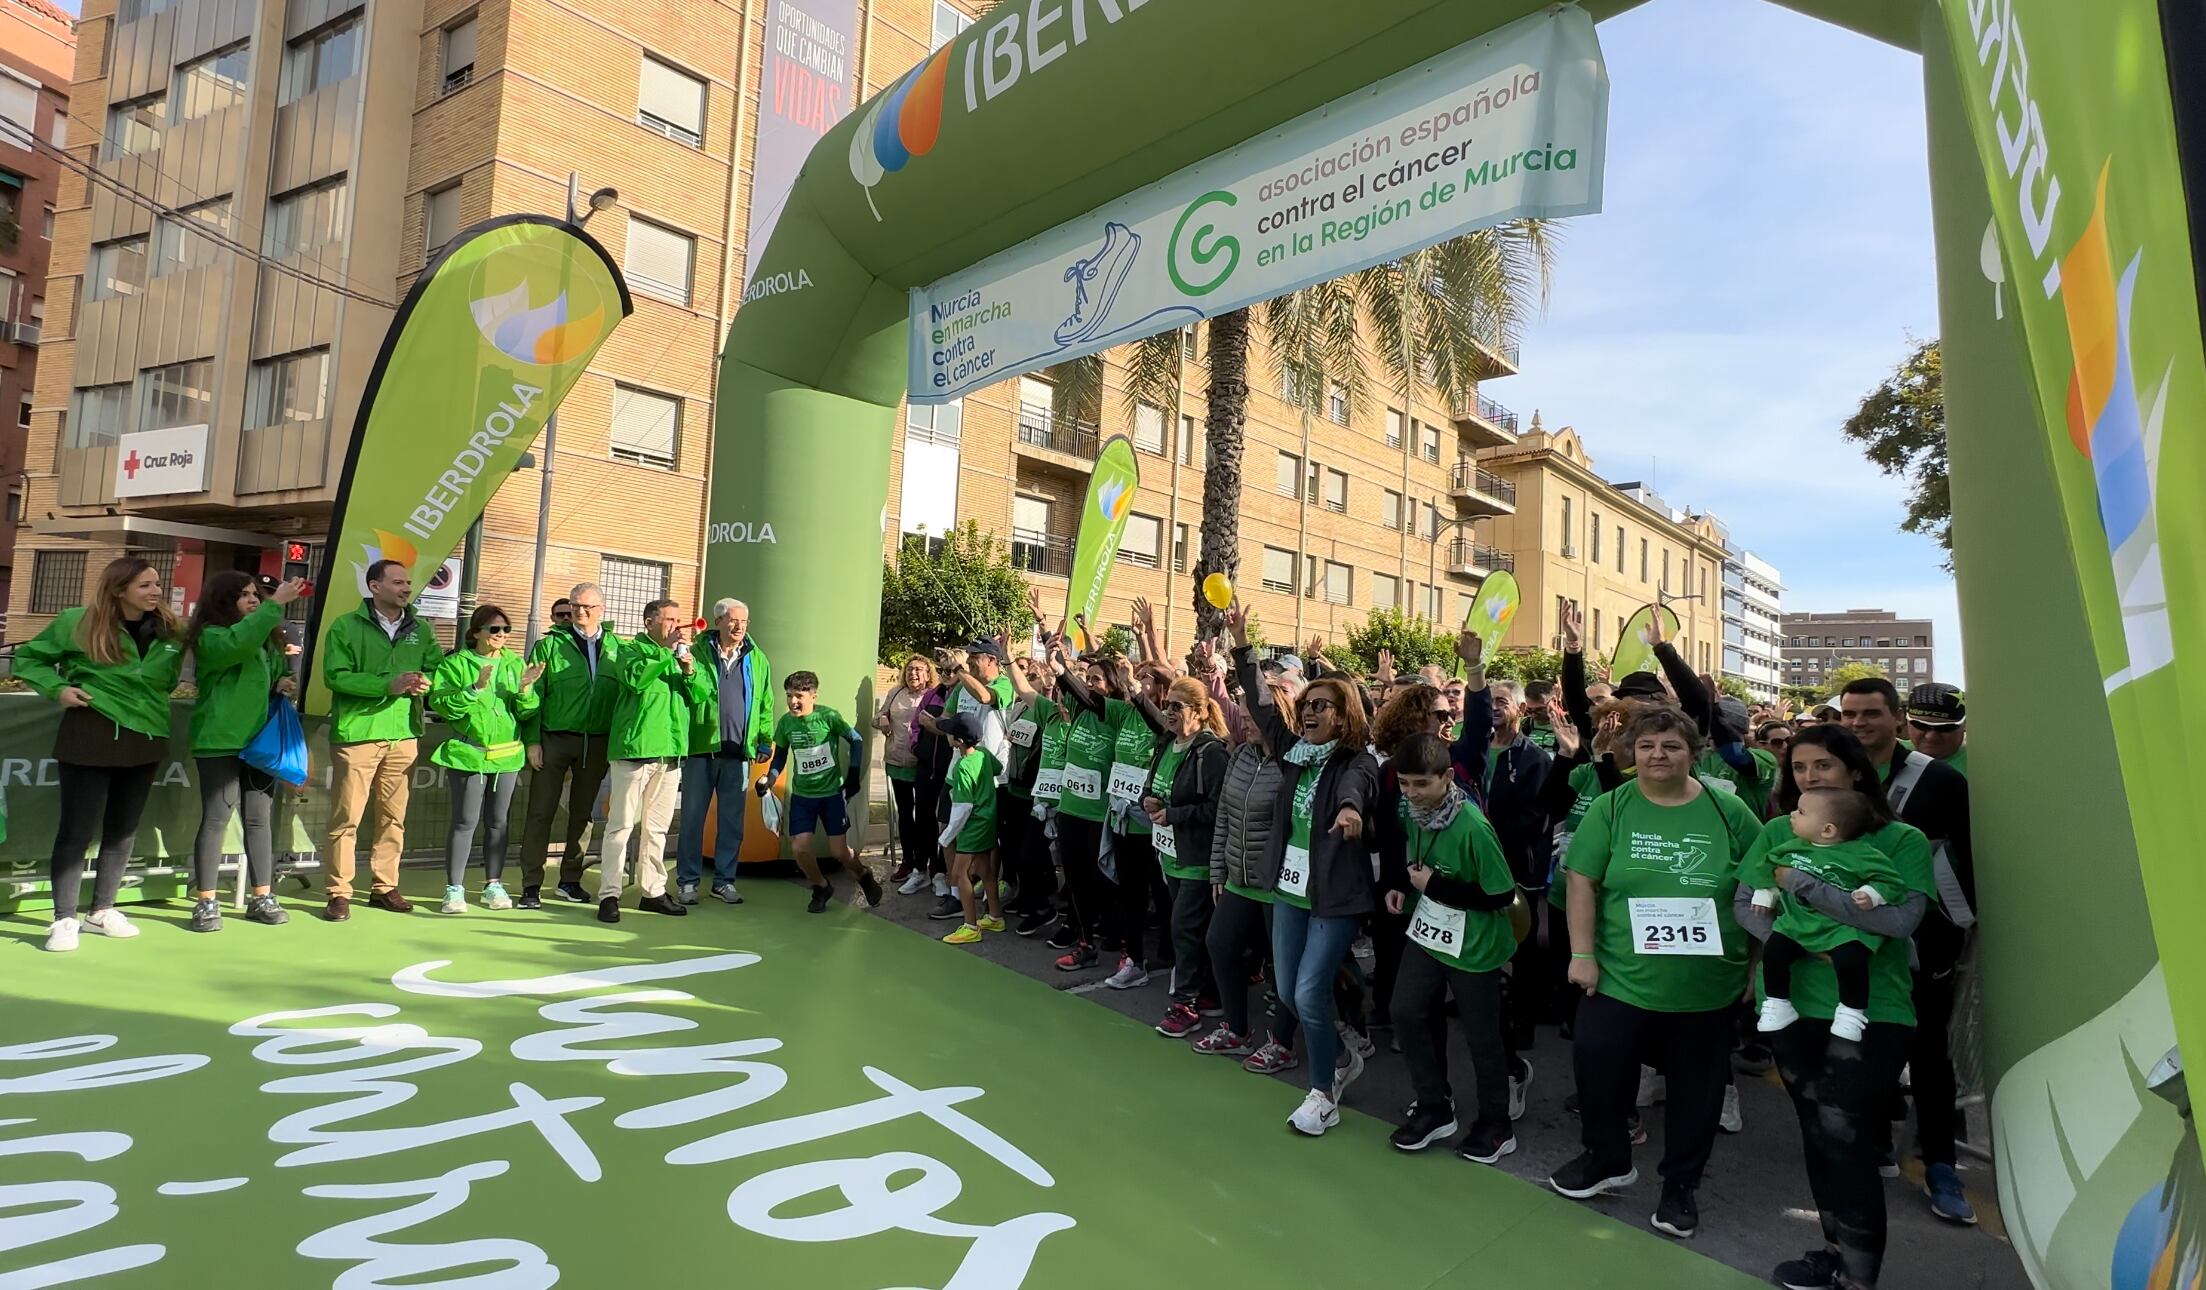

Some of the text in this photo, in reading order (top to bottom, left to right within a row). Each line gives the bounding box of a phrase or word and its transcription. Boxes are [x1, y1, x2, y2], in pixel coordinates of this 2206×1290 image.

[778, 1, 845, 56] OPORTUNIDADES
[776, 25, 844, 84] QUE CAMBIAN
[774, 54, 842, 135] VIDAS
[1258, 72, 1540, 201] asociación española
[1257, 139, 1472, 233] contra el cáncer
[1256, 143, 1577, 266] en la Región de Murcia
[931, 289, 981, 323] Murcia
[931, 301, 1012, 344] en marcha
[932, 335, 975, 366] contra
[933, 348, 996, 387] el cáncer
[143, 449, 193, 469] Cruz Roja
[403, 384, 543, 540] IBERDROLA
[708, 521, 777, 544] DROLA
[1010, 729, 1029, 741] 0877
[801, 756, 828, 769] 0882
[1038, 782, 1063, 794] 0260
[1067, 779, 1095, 793] 0613
[1113, 779, 1142, 794] 0145
[1631, 832, 1662, 841] Murcia
[1645, 841, 1680, 849] marcha
[1630, 846, 1661, 854] contra
[1641, 853, 1674, 861] cáncer
[1415, 918, 1453, 944] 0278
[1645, 925, 1707, 943] 2315
